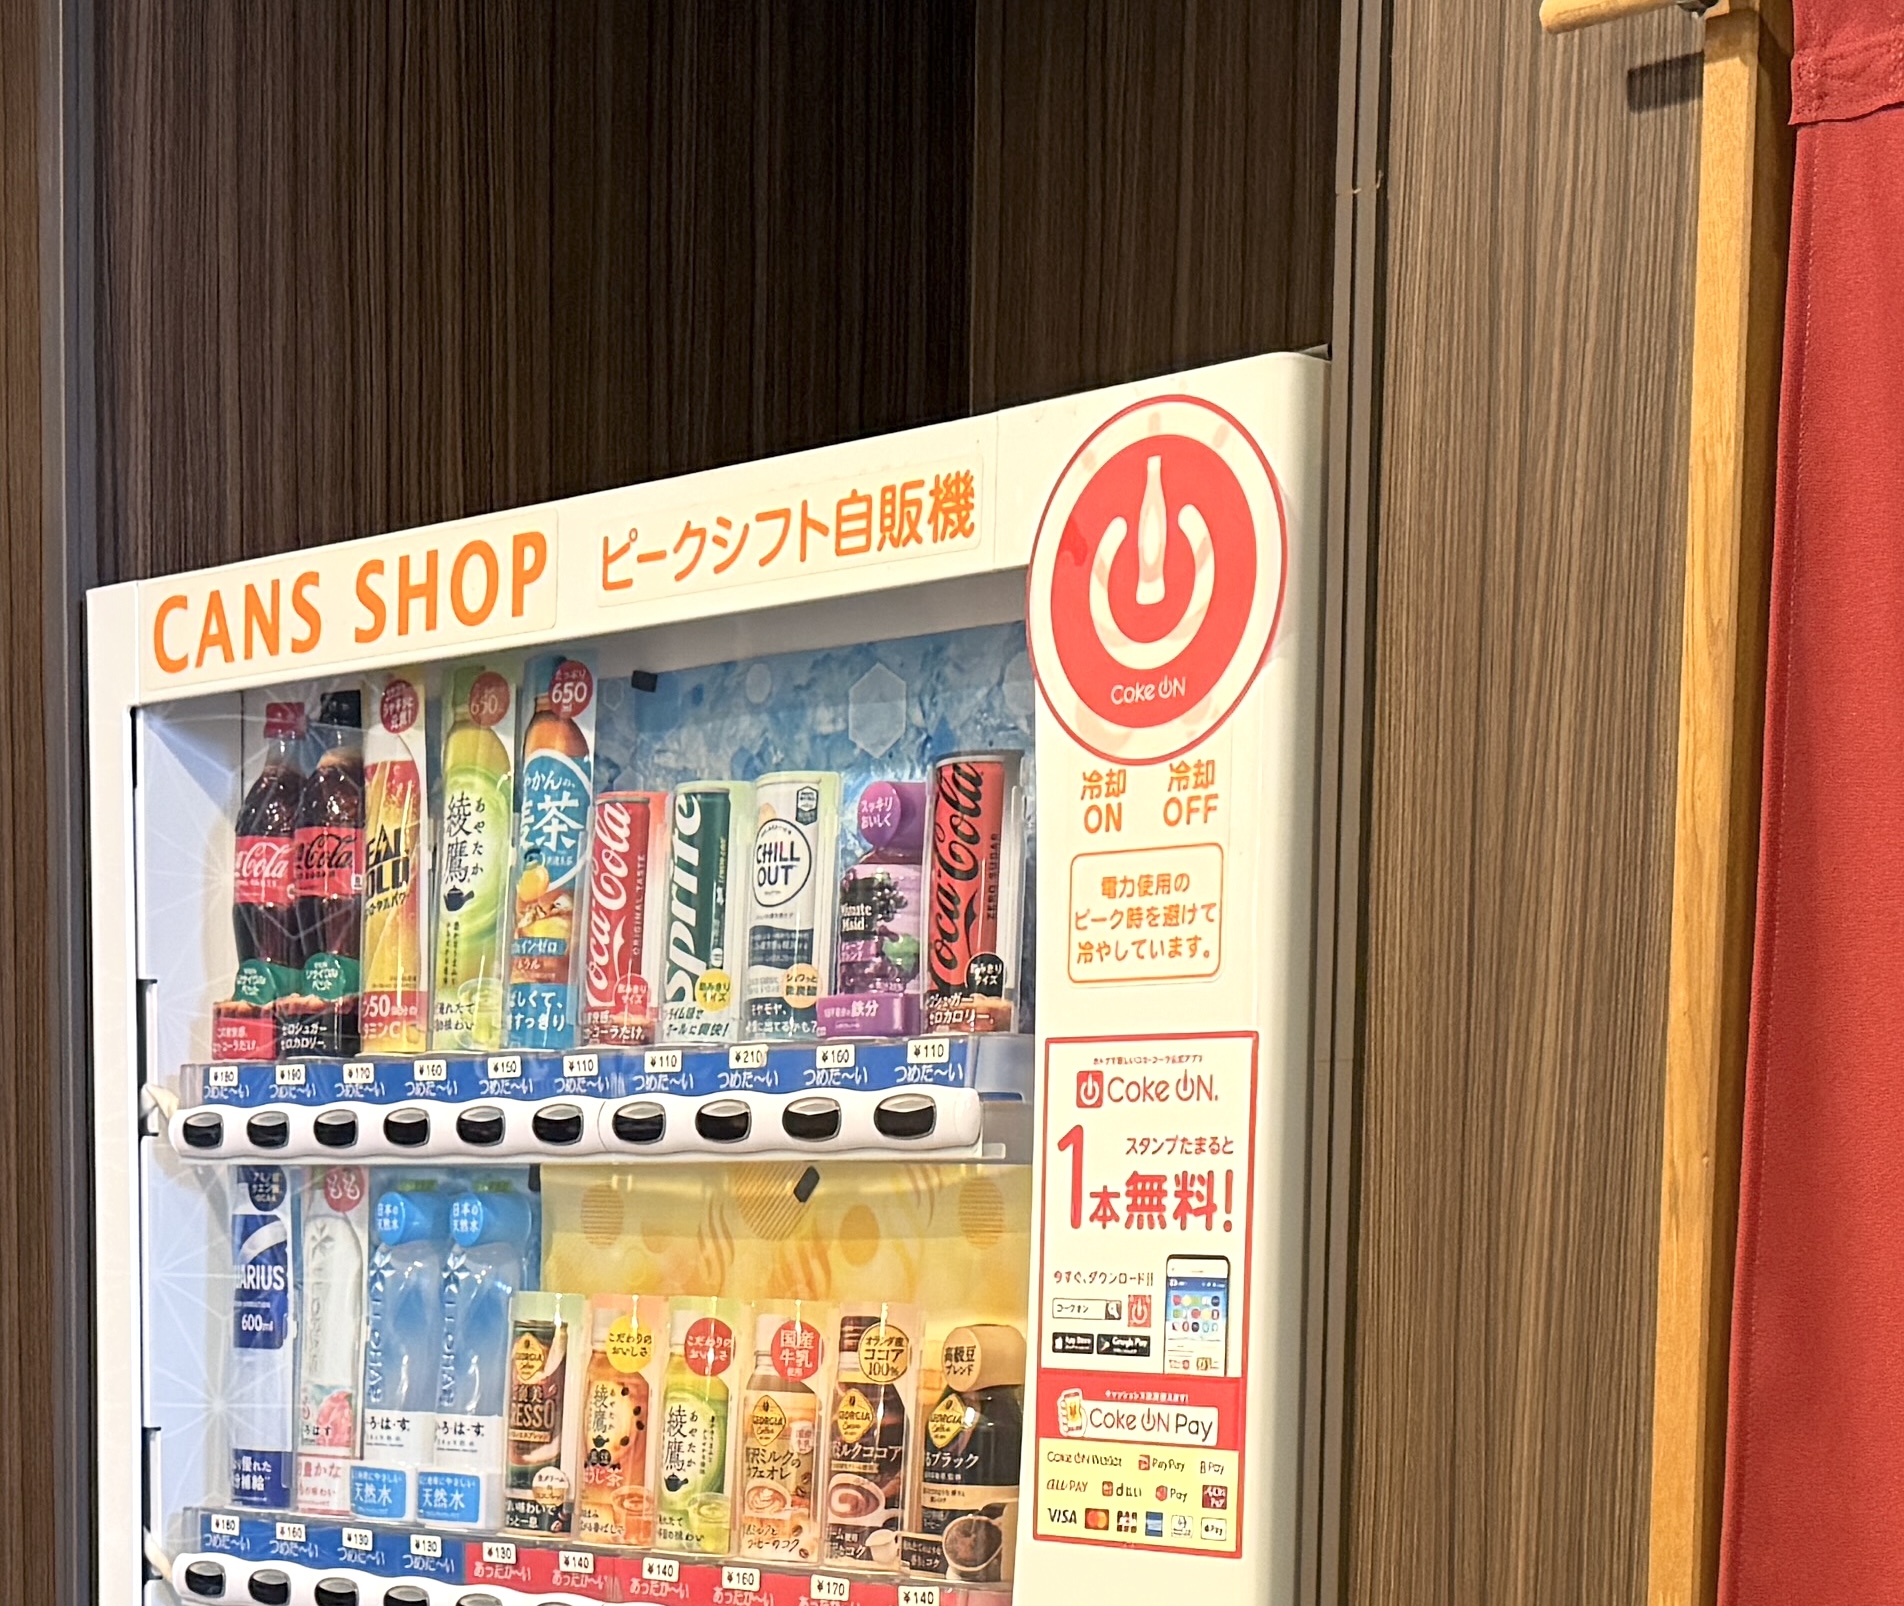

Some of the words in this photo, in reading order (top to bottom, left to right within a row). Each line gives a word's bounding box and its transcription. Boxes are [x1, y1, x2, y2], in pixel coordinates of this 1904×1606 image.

[601, 468, 977, 592] ピークシフト自販機
[153, 570, 323, 674] CANS
[354, 530, 548, 644] SHOP
[551, 679, 588, 703] 650
[1110, 681, 1156, 705] Coke
[1158, 674, 1186, 700] ON
[1081, 768, 1127, 801] 冷却
[1167, 759, 1216, 792] 冷却
[860, 796, 893, 814] スッキリ
[1162, 793, 1219, 827] OFF
[860, 813, 892, 830] おいしく
[1083, 803, 1123, 834] ON
[445, 794, 472, 884] 綾鷹
[756, 840, 801, 864] CHILL
[757, 865, 794, 888] OUT
[1100, 872, 1191, 899] 電力使用の
[1074, 902, 1218, 932] ピーク時を避けて
[1076, 935, 1211, 965] 冷やしています。
[734, 1049, 763, 1064] ¥210
[821, 1048, 850, 1064] ¥160
[913, 1043, 944, 1058] ¥110
[568, 1058, 594, 1072] ¥110
[650, 1054, 678, 1068] ¥110
[1108, 1076, 1170, 1103] Coke
[1125, 1134, 1234, 1156] スタンプたまると
[327, 1174, 361, 1200] もも
[452, 1202, 478, 1219] 日本の
[452, 1218, 481, 1234] 天然水
[608, 1333, 653, 1345] こだわりの
[687, 1335, 732, 1349] こだわりの
[779, 1329, 815, 1350] 国産
[611, 1346, 649, 1357] おいしさ
[779, 1349, 814, 1369] 牛乳
[864, 1348, 905, 1362] ココア
[944, 1345, 976, 1364] 高級豆
[868, 1361, 899, 1378] 100%
[944, 1362, 976, 1377] ブレンド
[592, 1384, 609, 1434] 綾鷹
[1089, 1407, 1137, 1431] Coke
[1141, 1407, 1170, 1433] ON
[1175, 1412, 1213, 1443] Pay
[664, 1404, 688, 1472] 綾鷹
[687, 1414, 699, 1468] あやたか
[354, 1482, 393, 1506] 天然水
[421, 1487, 466, 1510] 天然水
[1047, 1507, 1078, 1525] VISA
[346, 1533, 369, 1546] ¥130
[414, 1539, 437, 1553] ¥130
[487, 1546, 512, 1560] ¥130
[563, 1556, 590, 1569] ¥140
[647, 1563, 674, 1578] ¥140
[726, 1571, 755, 1586] ¥160
[816, 1580, 845, 1597] ¥170
[903, 1591, 934, 1605] ¥140
